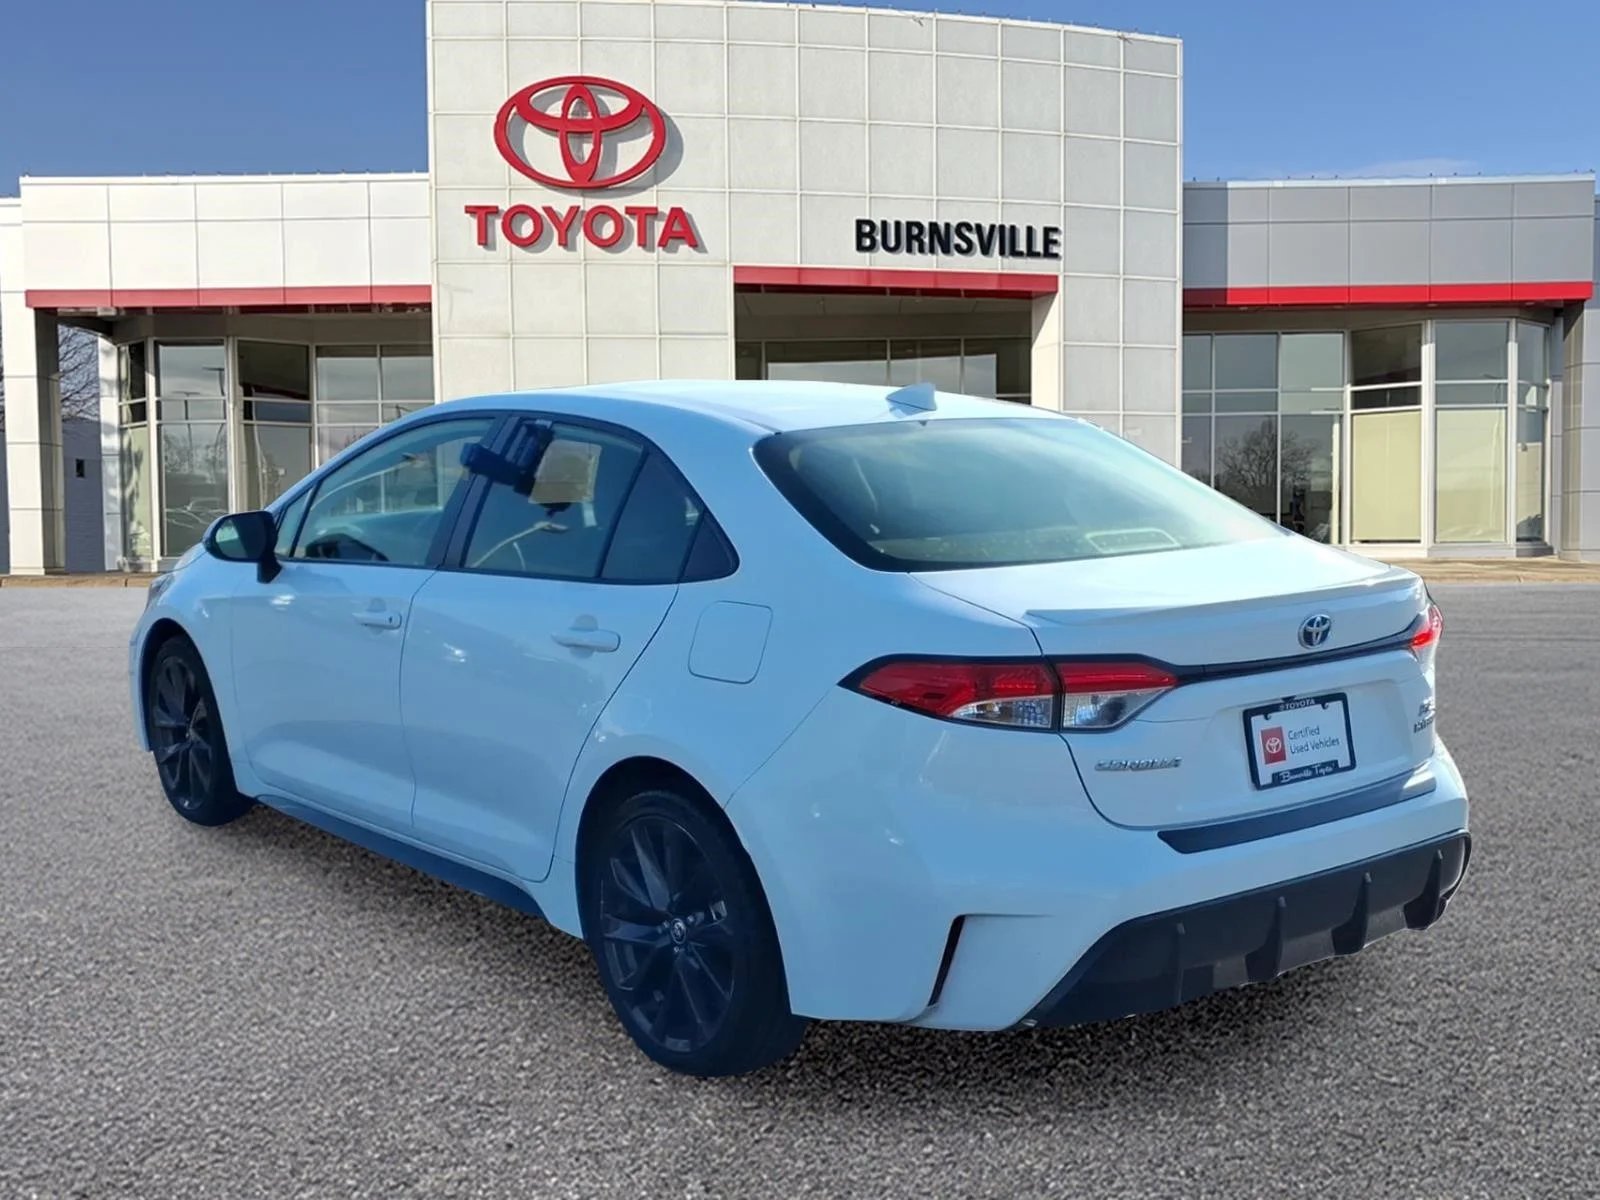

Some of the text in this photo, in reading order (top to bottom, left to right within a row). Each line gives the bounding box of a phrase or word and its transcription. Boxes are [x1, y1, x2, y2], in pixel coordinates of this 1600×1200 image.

[465, 205, 699, 249] TOYOTA
[855, 217, 1061, 258] BURNSVILLE
[1285, 699, 1315, 709] TOYOTA
[1288, 726, 1320, 741] Certified
[1290, 736, 1340, 755] Used Vehicles
